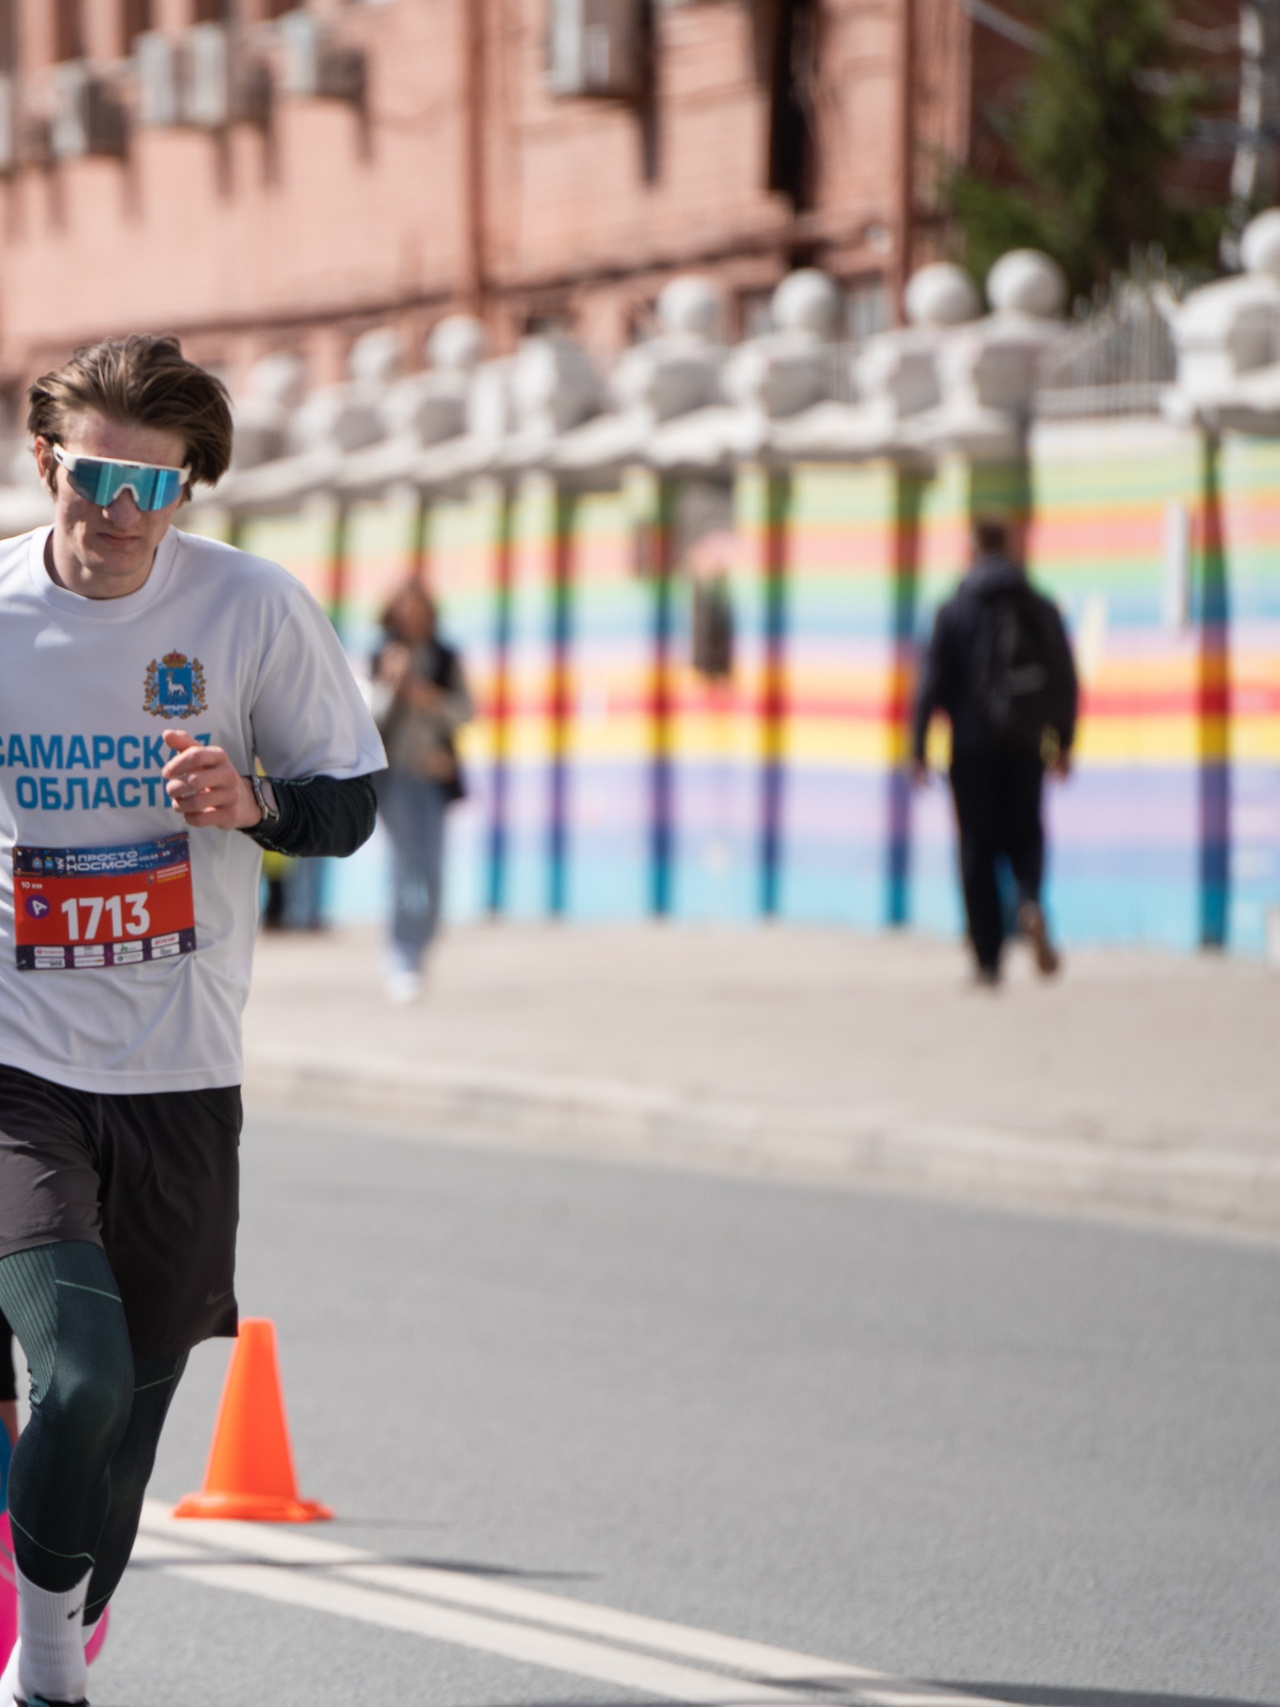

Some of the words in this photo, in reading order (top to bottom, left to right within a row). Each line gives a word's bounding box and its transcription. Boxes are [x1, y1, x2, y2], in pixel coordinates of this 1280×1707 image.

[77, 850, 138, 864] ПРОСТО
[66, 858, 138, 872] КОСМОС
[61, 891, 151, 941] 1713
